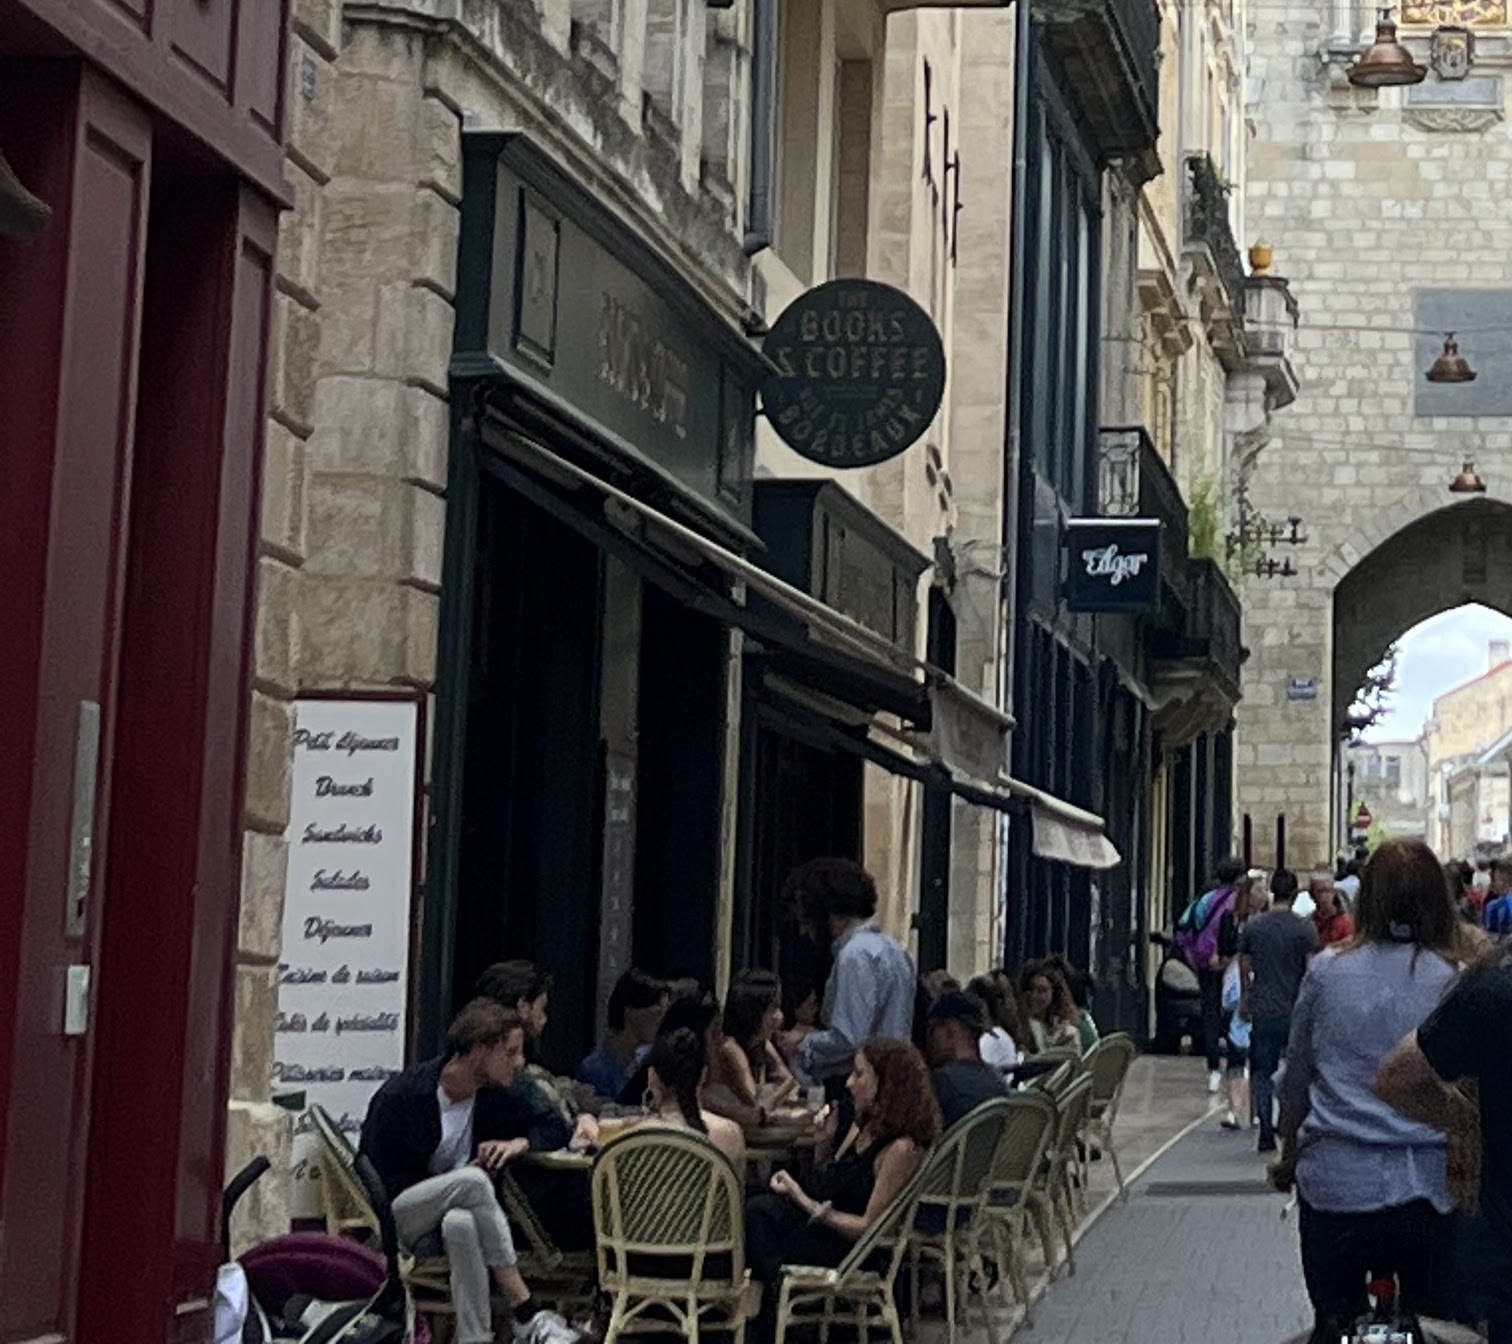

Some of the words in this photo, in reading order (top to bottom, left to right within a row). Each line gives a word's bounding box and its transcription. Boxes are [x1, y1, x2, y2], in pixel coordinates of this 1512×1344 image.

[802, 311, 905, 342] BOOKS
[805, 347, 929, 379] COFFEE
[330, 963, 351, 985] de
[310, 1011, 331, 1033] de
